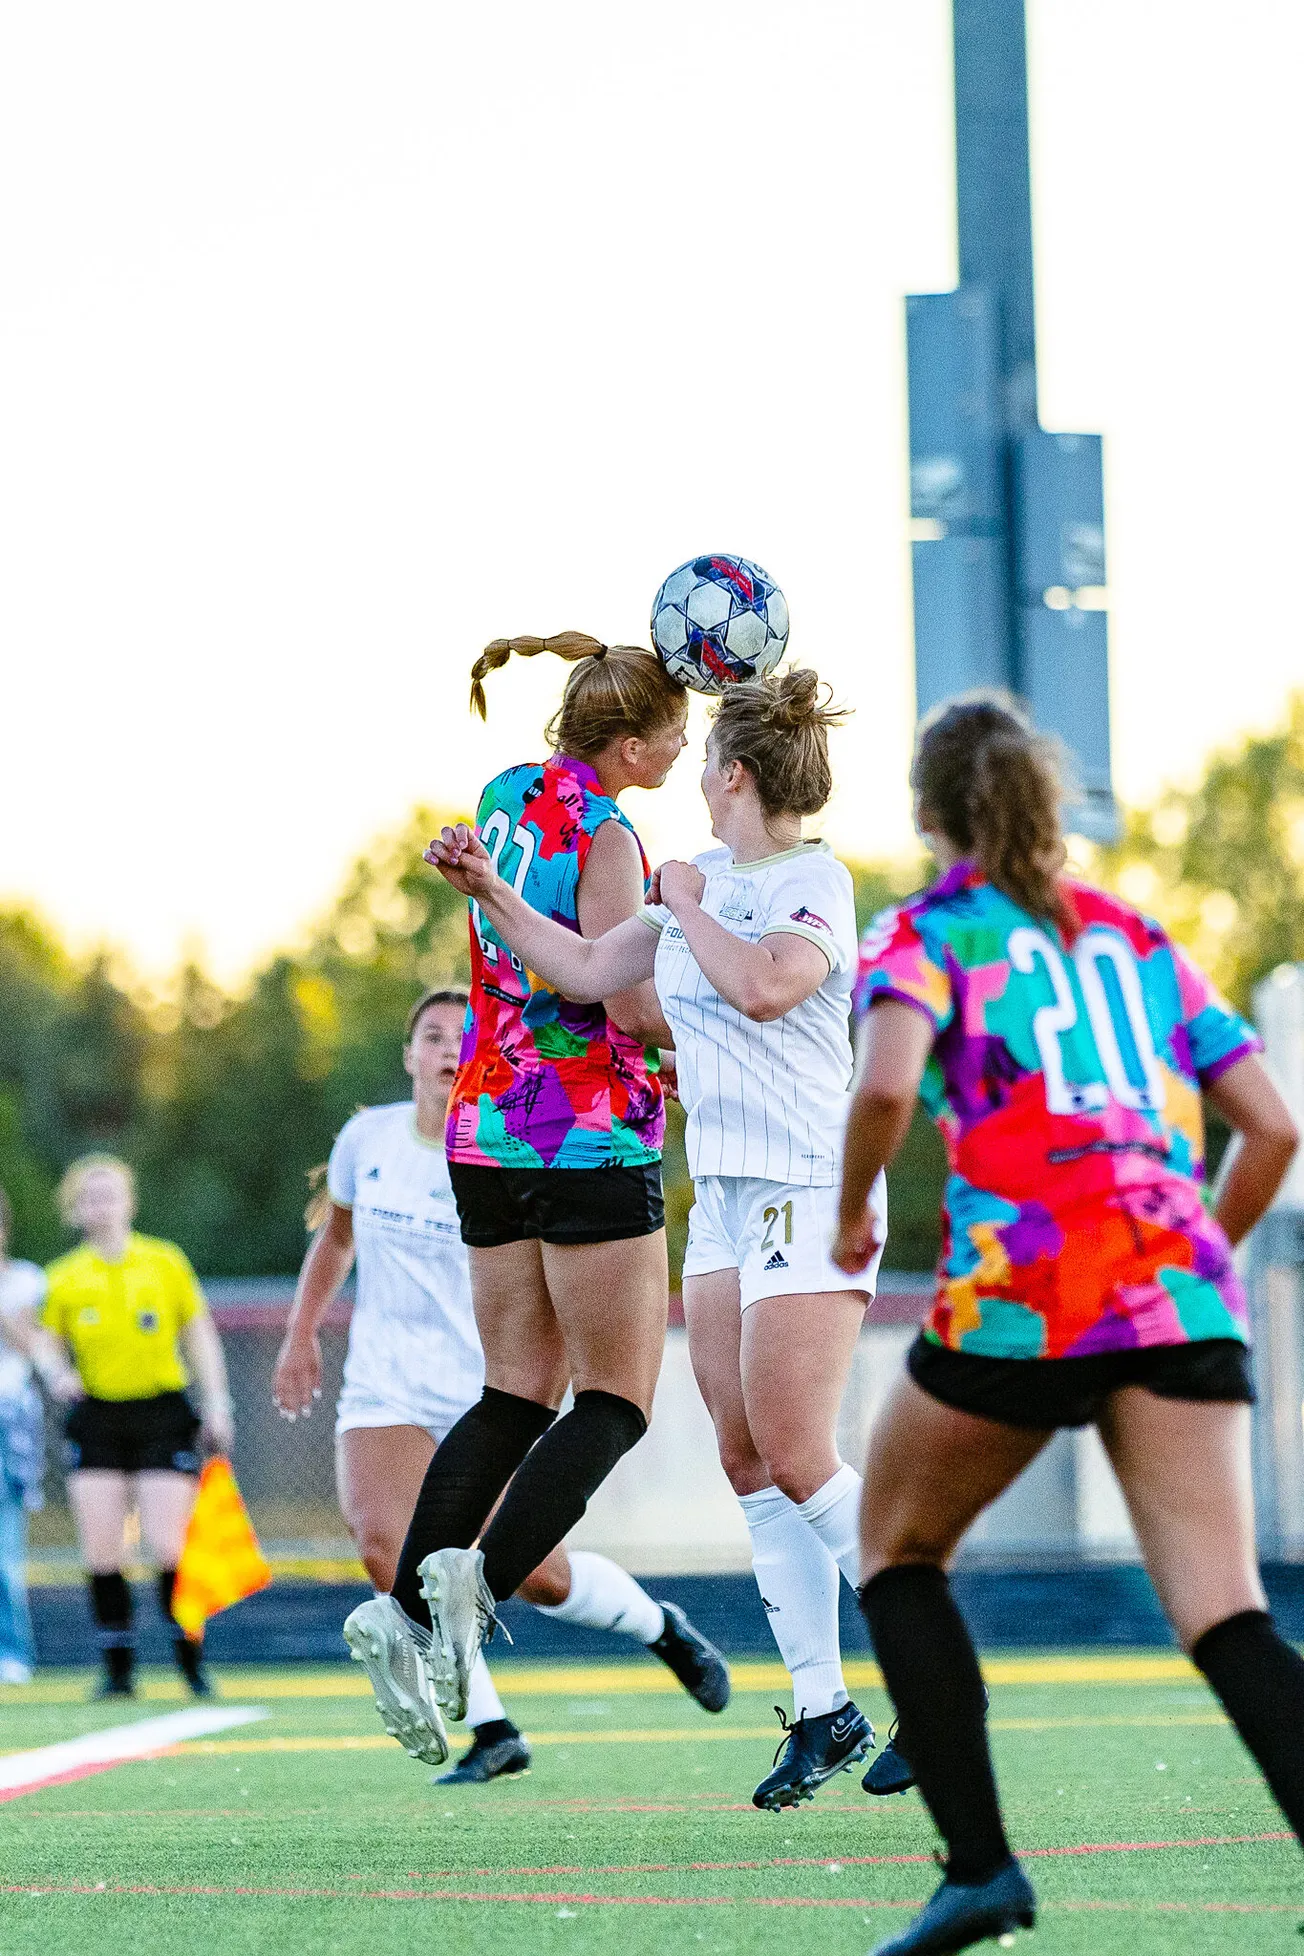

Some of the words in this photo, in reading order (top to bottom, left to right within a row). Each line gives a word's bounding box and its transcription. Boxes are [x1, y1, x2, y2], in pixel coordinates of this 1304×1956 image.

[1007, 927, 1166, 1116] 20
[760, 1200, 794, 1254] 21
[764, 1261, 789, 1271] adidas
